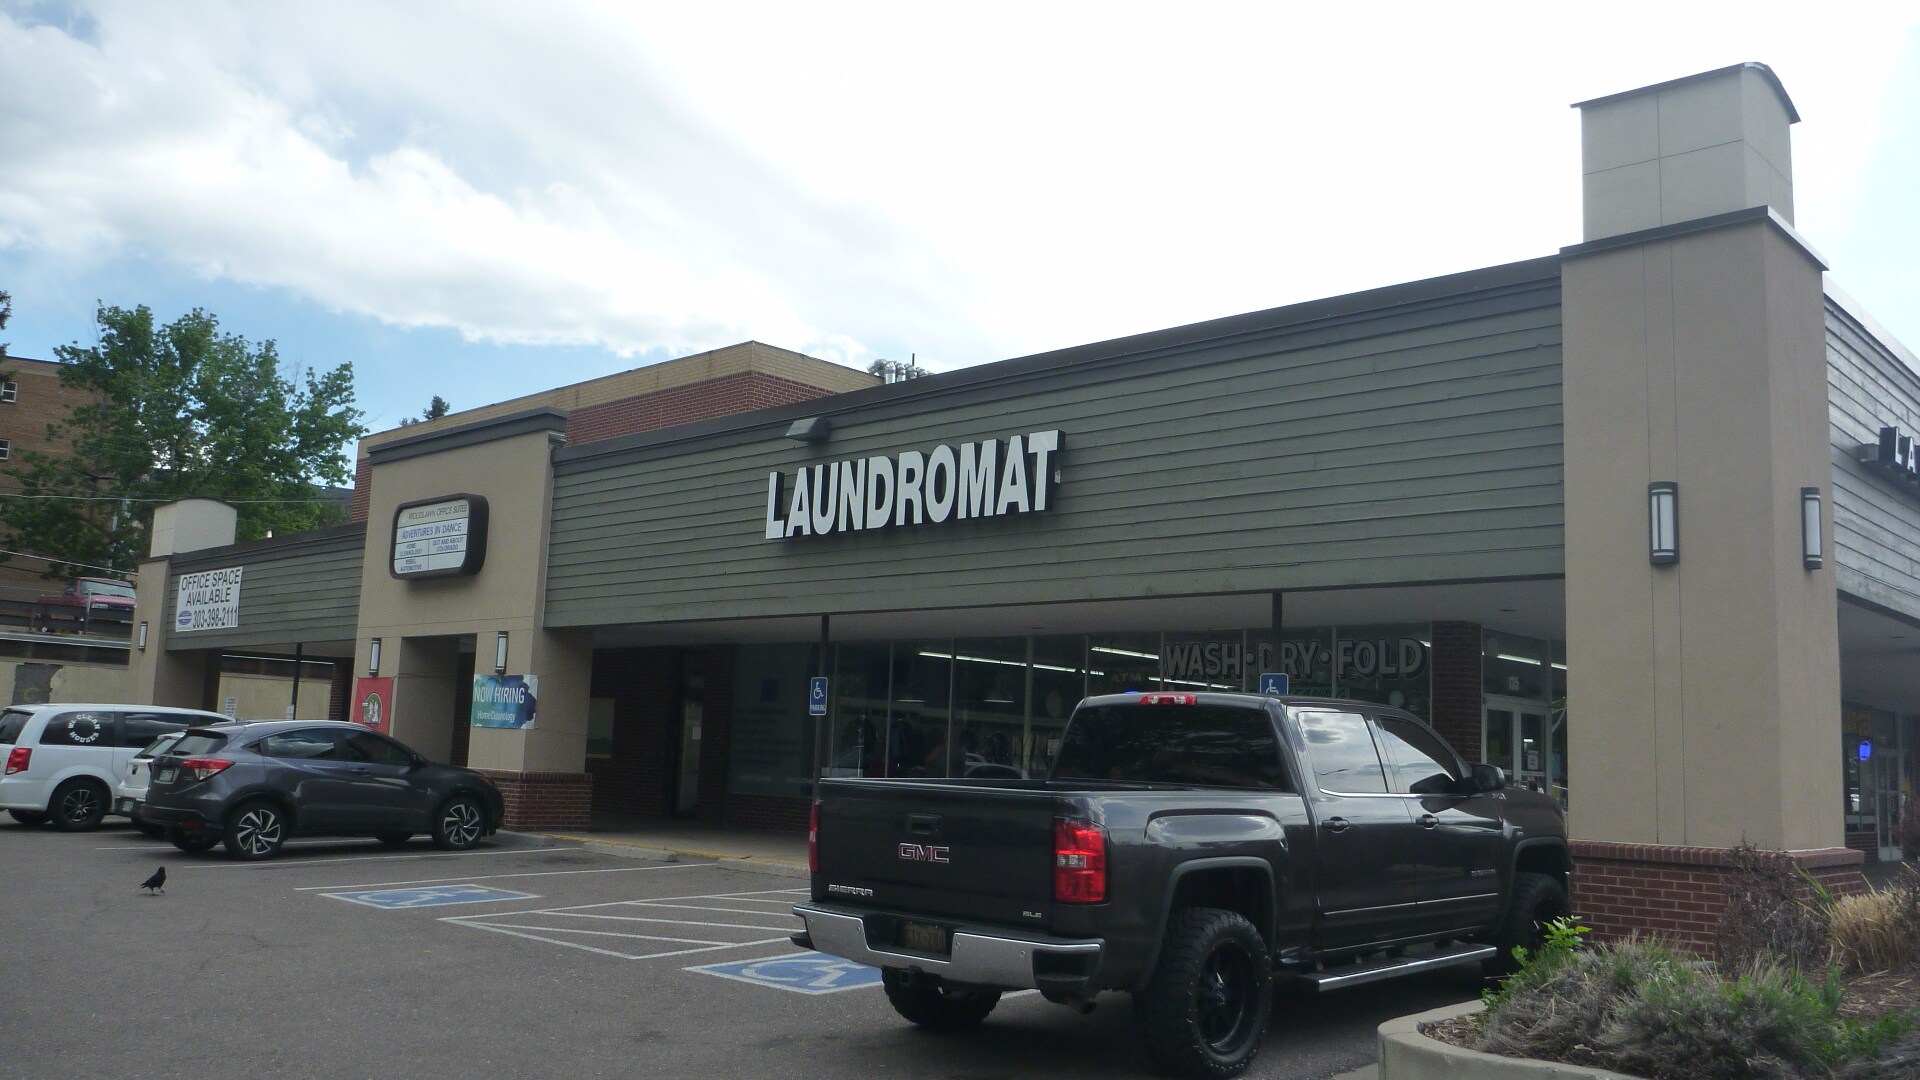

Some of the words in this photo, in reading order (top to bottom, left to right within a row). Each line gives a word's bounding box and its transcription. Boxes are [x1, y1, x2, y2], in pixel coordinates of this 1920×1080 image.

[765, 429, 1061, 539] LAUNDROMAT
[436, 506, 453, 517] OFFICE
[453, 504, 468, 514] SUITES
[402, 527, 434, 539] ADVENTURES
[434, 525, 441, 534] IN
[442, 522, 462, 534] DANCE
[437, 544, 458, 552] COLORADO
[449, 536, 464, 544] ABOUT
[400, 564, 422, 572] AUTOMOTIVE
[181, 573, 210, 591] OFFICE
[212, 569, 241, 587] SPACE
[186, 587, 231, 607] AVAILABLE
[193, 606, 238, 628] 303-398-2111
[1164, 641, 1243, 680] WASH
[1256, 640, 1318, 678] DRY
[1336, 637, 1428, 680] FOLD
[473, 686, 494, 703] NOW
[494, 687, 525, 704] HIRING
[76, 713, 101, 730] CLEAN
[477, 710, 490, 720] Home
[490, 710, 516, 724] Cleanology
[69, 731, 100, 743] HOUSES
[898, 842, 950, 864] GMC
[828, 884, 874, 897] SIERRA
